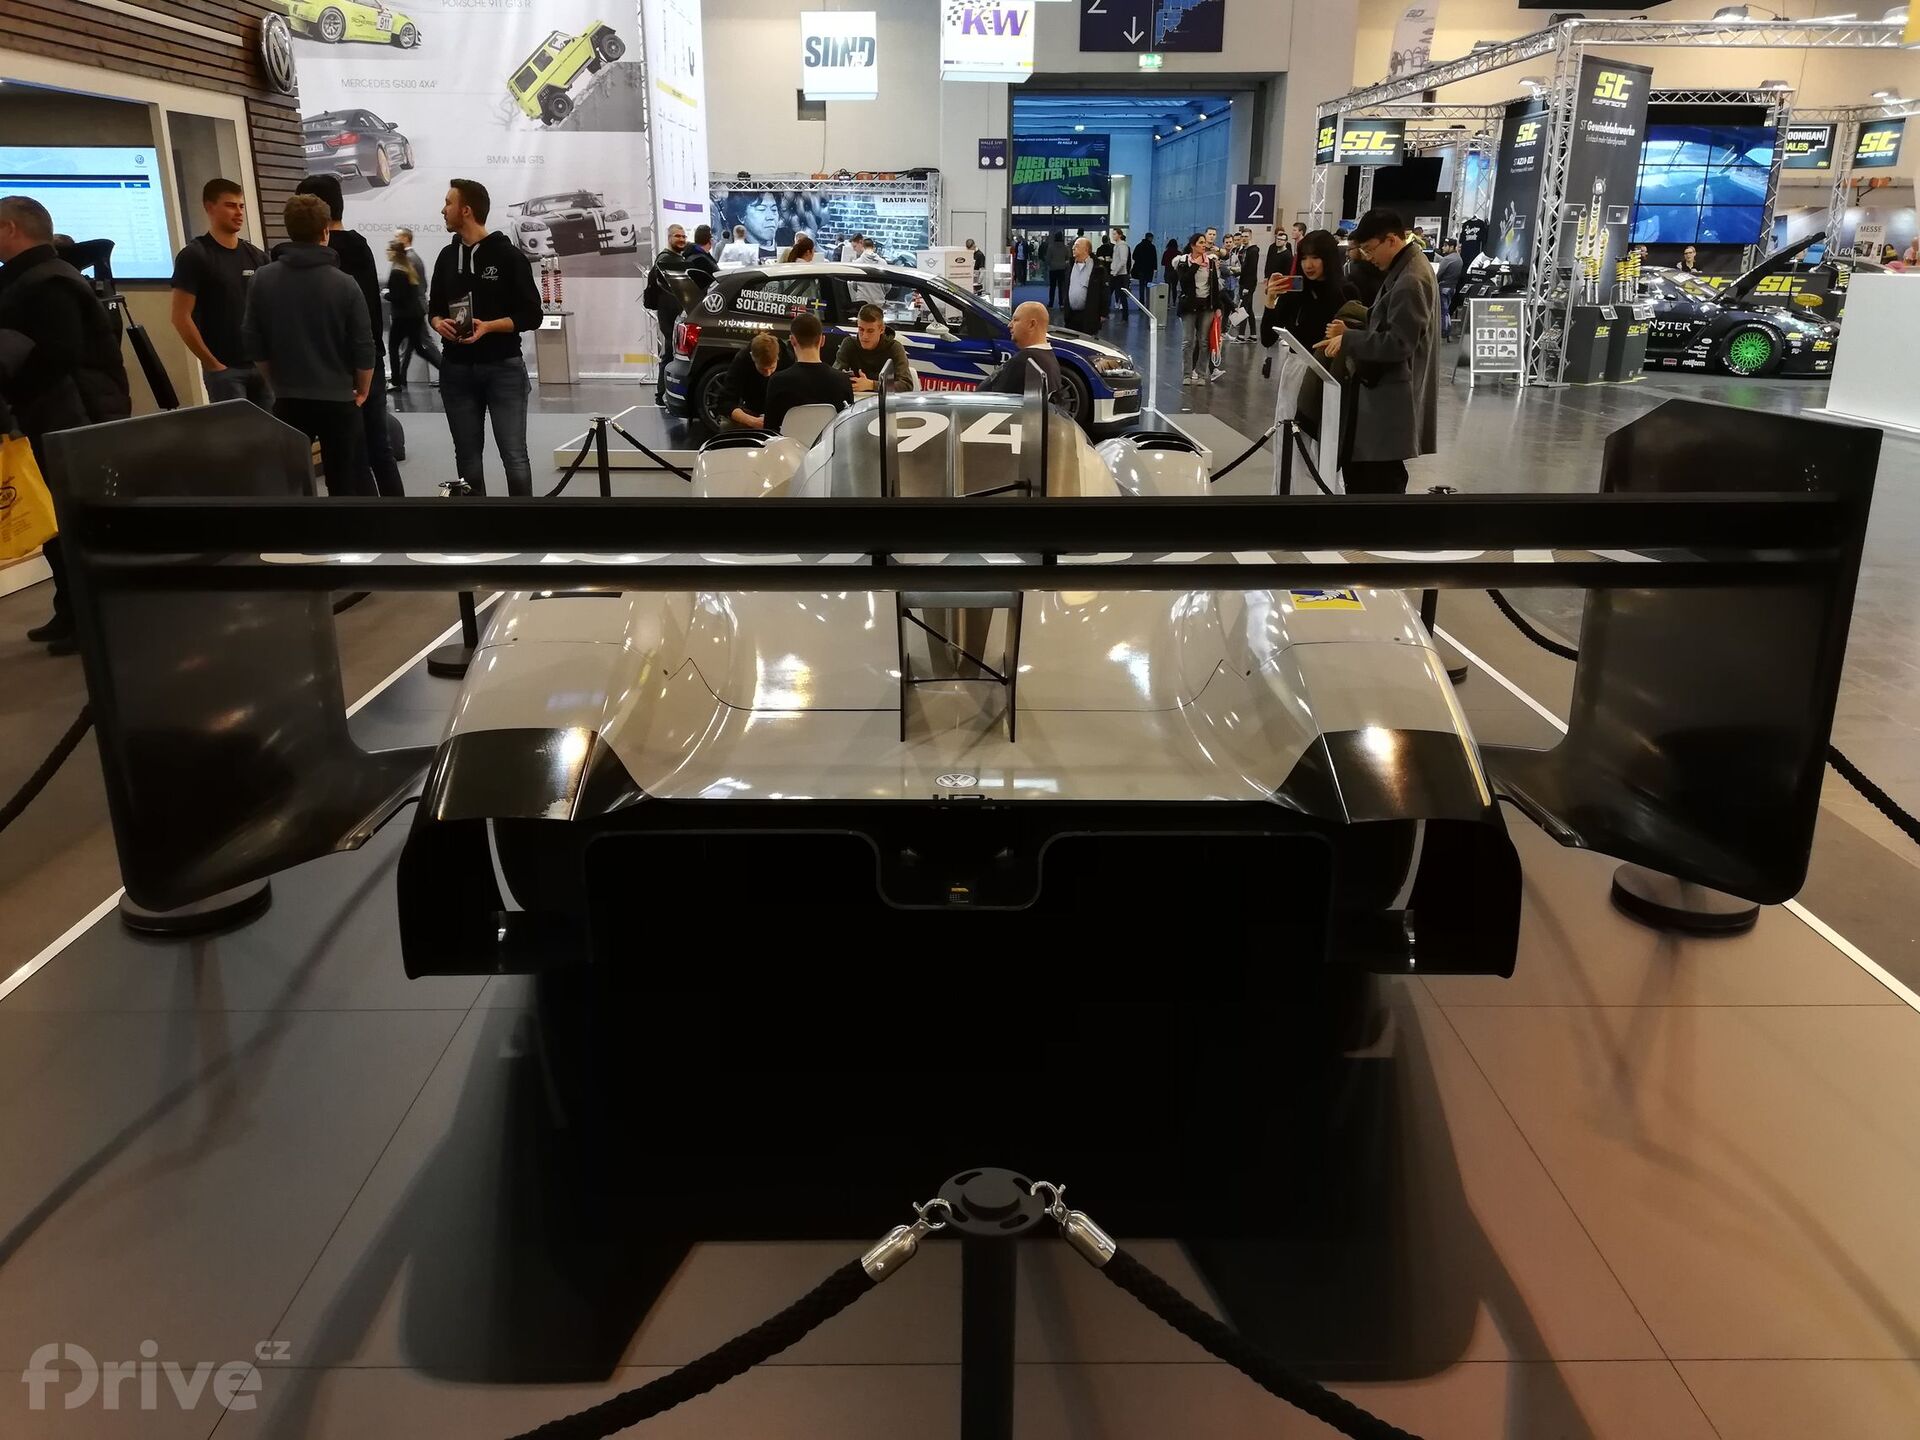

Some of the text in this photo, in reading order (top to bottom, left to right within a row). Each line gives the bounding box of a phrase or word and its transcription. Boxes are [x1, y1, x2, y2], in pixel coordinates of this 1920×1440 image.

[962, 9, 1028, 36] KW
[341, 79, 391, 89] MERCEDES
[487, 155, 509, 164] BMW
[1016, 156, 1046, 169] HIER
[1012, 168, 1065, 185] BREITER,
[1248, 191, 1264, 218] 2
[358, 223, 392, 232] DODGE
[740, 289, 808, 305] KRISTOFFERSSON
[736, 298, 786, 315] SOLBERG
[1649, 320, 1691, 331] NSTER
[867, 411, 1023, 455] 94
